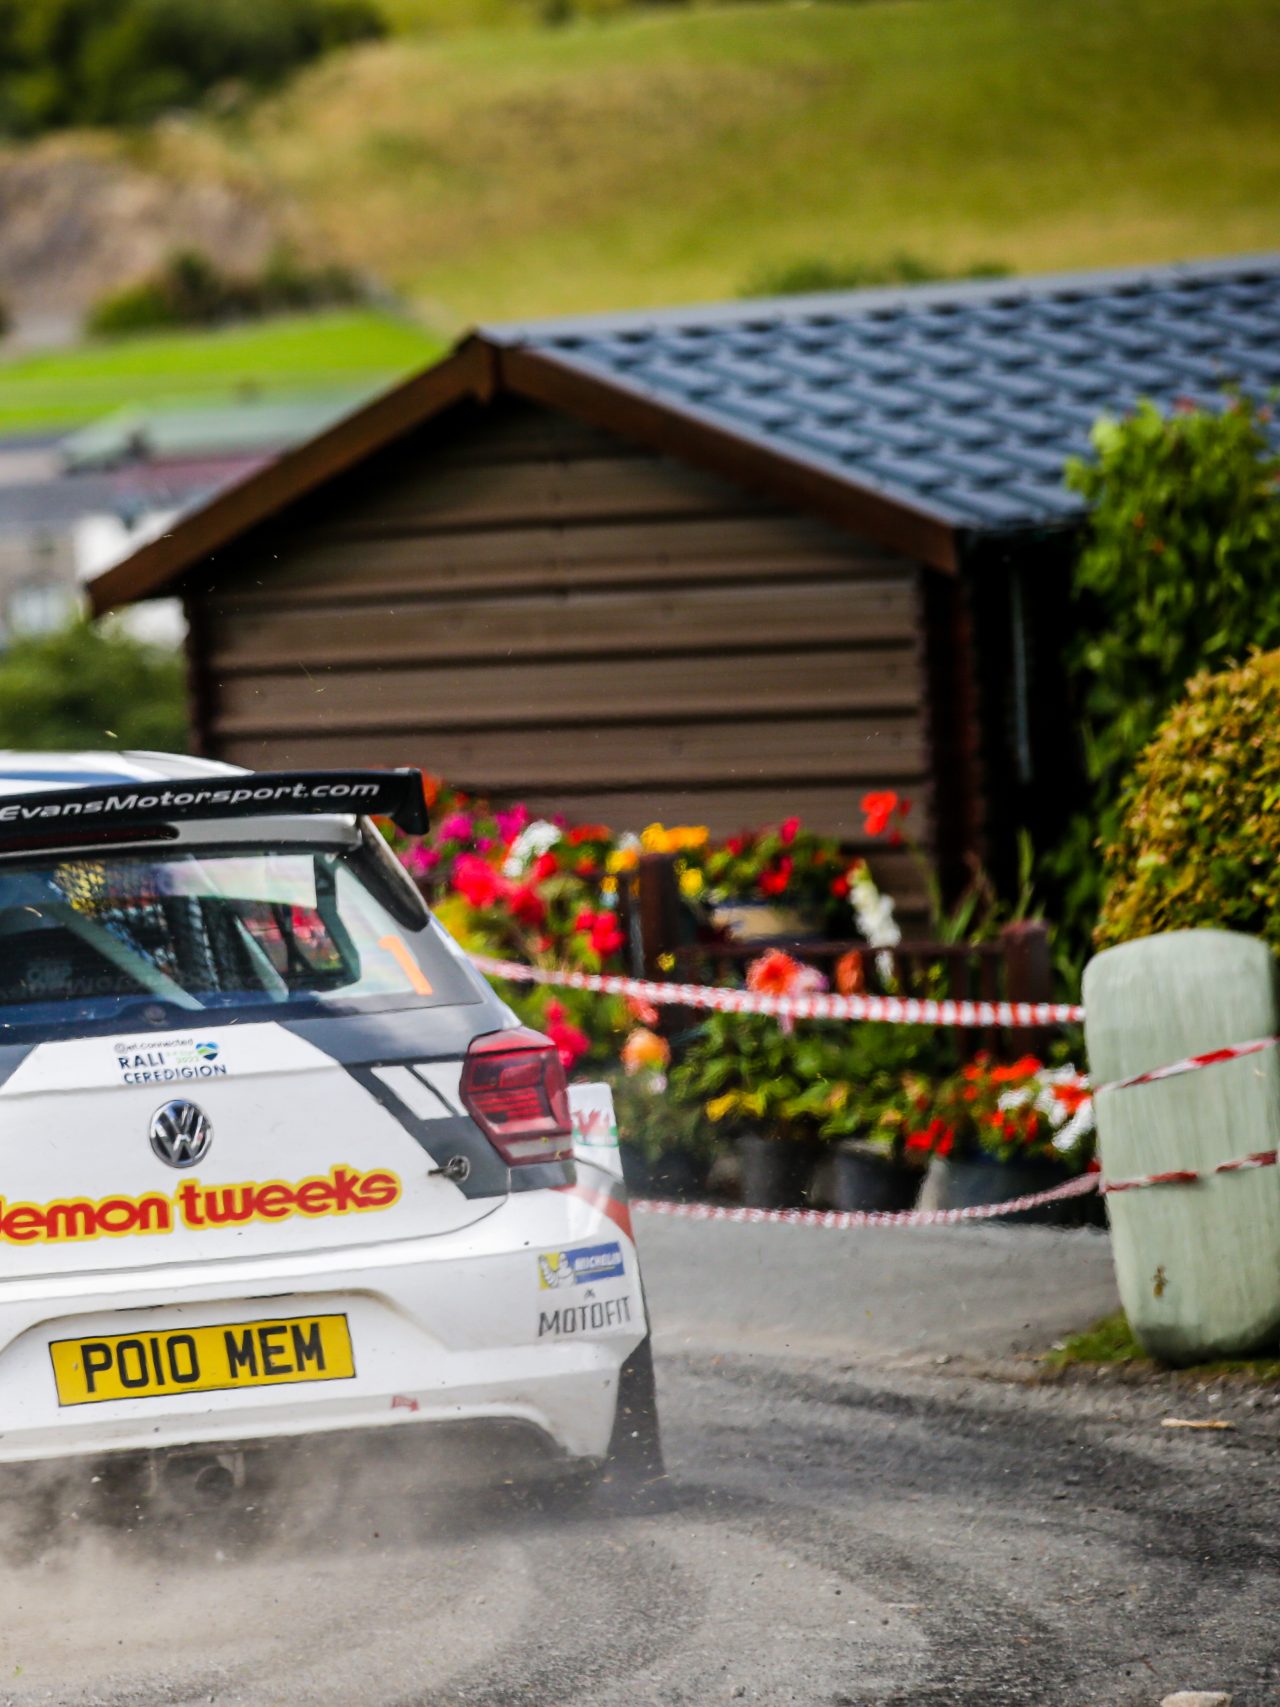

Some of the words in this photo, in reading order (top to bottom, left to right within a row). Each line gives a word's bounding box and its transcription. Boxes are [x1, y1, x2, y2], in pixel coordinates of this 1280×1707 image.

[118, 1052, 166, 1070] RALI
[123, 1064, 228, 1085] CEREDIGION
[178, 1169, 399, 1225] tweeks
[574, 1251, 622, 1272] MICHELIN
[538, 1296, 630, 1338] MOTOFIT
[224, 1322, 327, 1379] MEM
